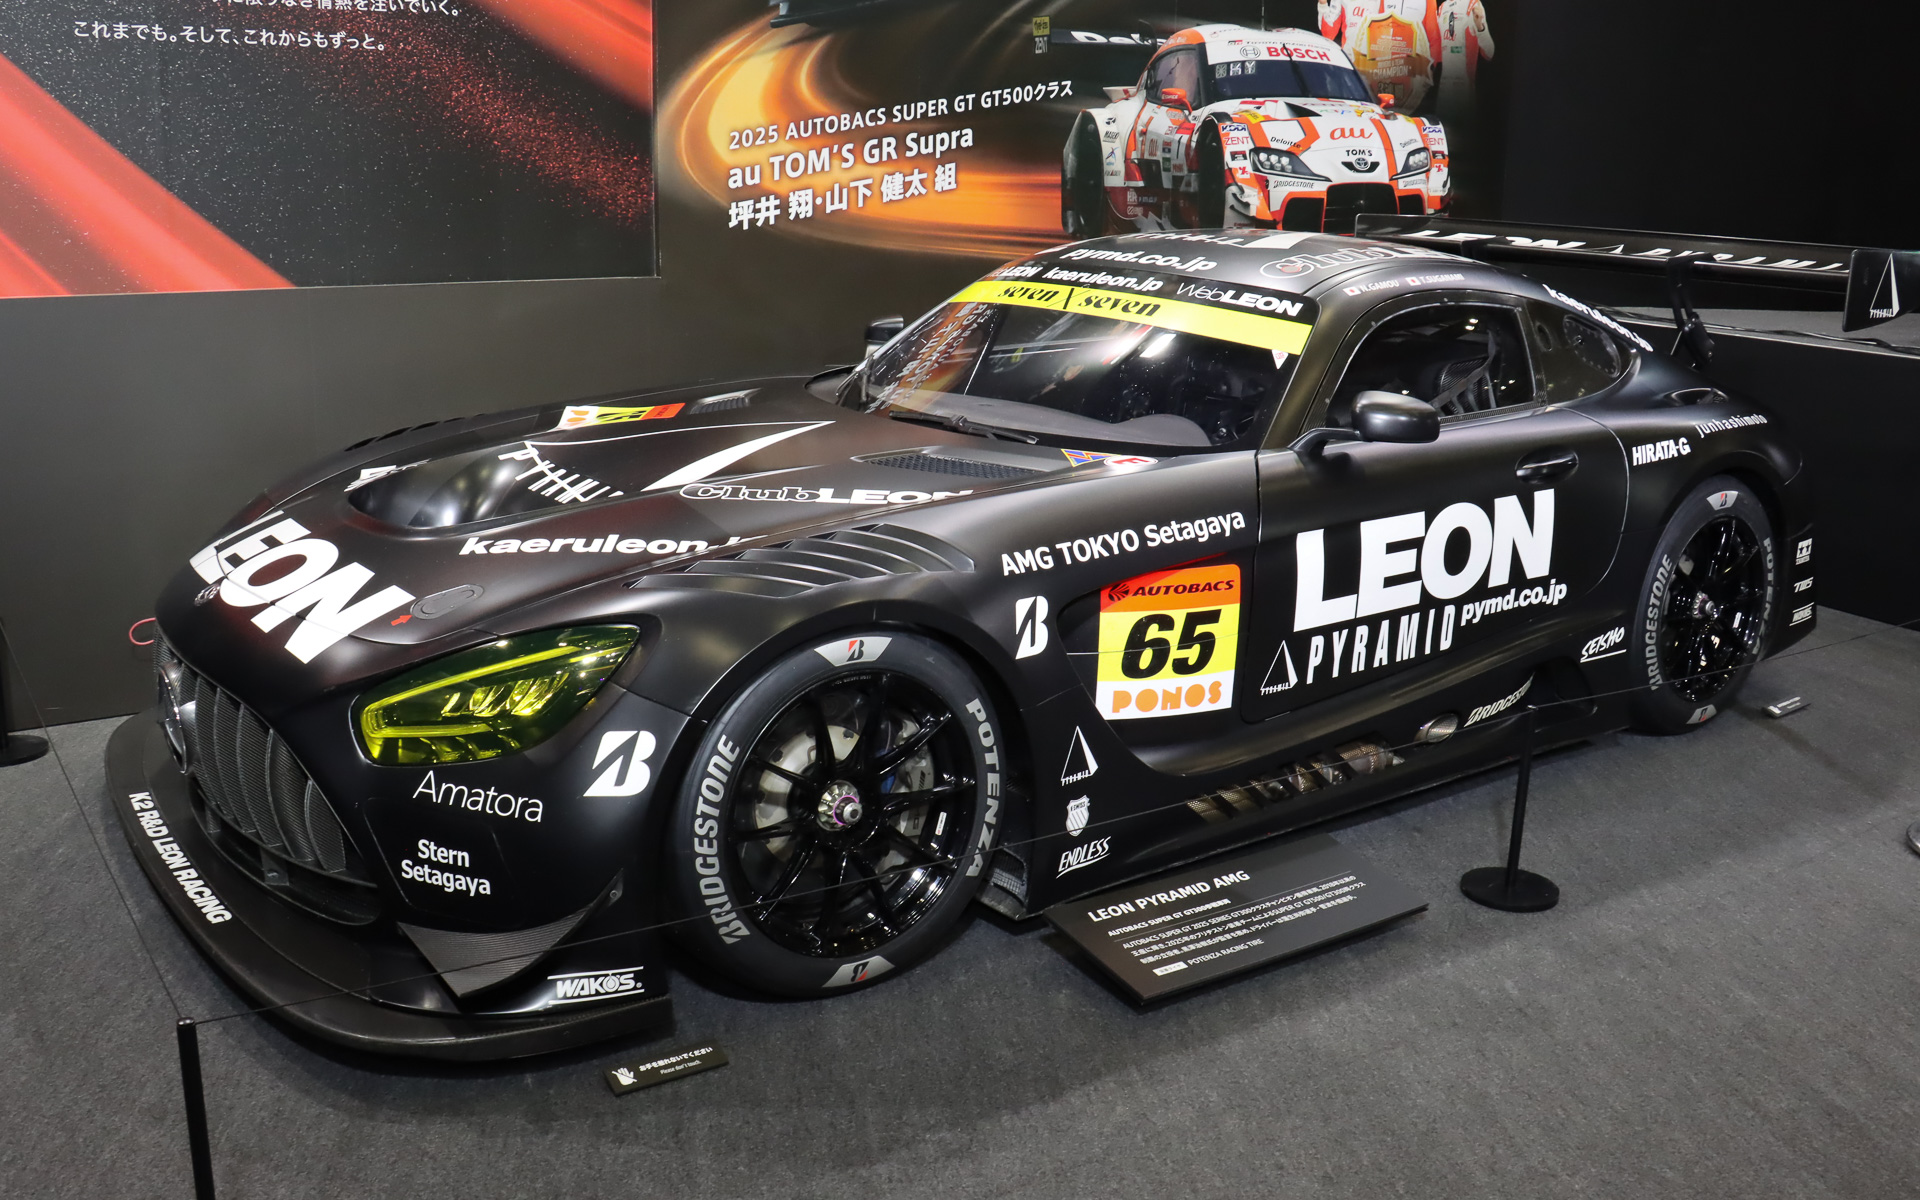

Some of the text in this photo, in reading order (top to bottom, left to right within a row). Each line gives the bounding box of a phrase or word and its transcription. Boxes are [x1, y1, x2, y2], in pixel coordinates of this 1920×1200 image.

[74, 20, 385, 51] これまでも。そして、これからもずっと。
[1266, 46, 1331, 61] BOSCH
[729, 80, 1073, 150] 2025 AUTOBACS SUPER GT GT500クラス
[1330, 127, 1374, 140] au
[728, 127, 974, 189] au TOM'S GR Supra
[1224, 136, 1249, 146] ZENT
[1345, 148, 1373, 157] TOM'S
[728, 195, 780, 231] 坪井
[881, 169, 928, 203] 健太
[934, 163, 957, 192] 組
[1273, 180, 1315, 189] BRIDGESTONE
[1059, 248, 1218, 272] pymd.co.jp
[998, 284, 1060, 302] seven
[1077, 295, 1161, 317] seven
[1042, 266, 1164, 292] kaeruleon.jp
[1177, 281, 1304, 318] WebLEON
[1542, 283, 1654, 352] kaeruleon.jp
[1695, 413, 1768, 438] junhashimoto
[1632, 437, 1692, 467] HIRATA-G
[1001, 511, 1246, 577] AMG TOKYO Setagaya
[1293, 488, 1555, 633] LEON
[189, 510, 417, 664] LEON
[1131, 579, 1235, 597] AUTOBACS
[1306, 578, 1567, 685] PYRAMID pymd.co.jp
[1645, 554, 1672, 691] BRIDGESTONE
[1121, 608, 1222, 680] 65
[1580, 626, 1625, 660] SEISHO
[1111, 680, 1223, 713] PONOS
[412, 769, 544, 823] Amatora
[965, 697, 1000, 877] POTENZA
[129, 791, 233, 924] K2 R&D LEON RACING
[417, 838, 470, 868] Stern
[693, 734, 750, 945] BRIDGESTONE
[1058, 836, 1112, 873] ENDLESS
[401, 859, 491, 897] Setagaya
[1087, 870, 1251, 922] LEON PYRAMID AMG
[1107, 921, 1149, 937] AUTOBACS
[1149, 914, 1174, 927] SUPER
[1174, 911, 1184, 919] GT
[1187, 951, 1221, 965] POTENZA
[556, 972, 636, 998] WAKO'S
